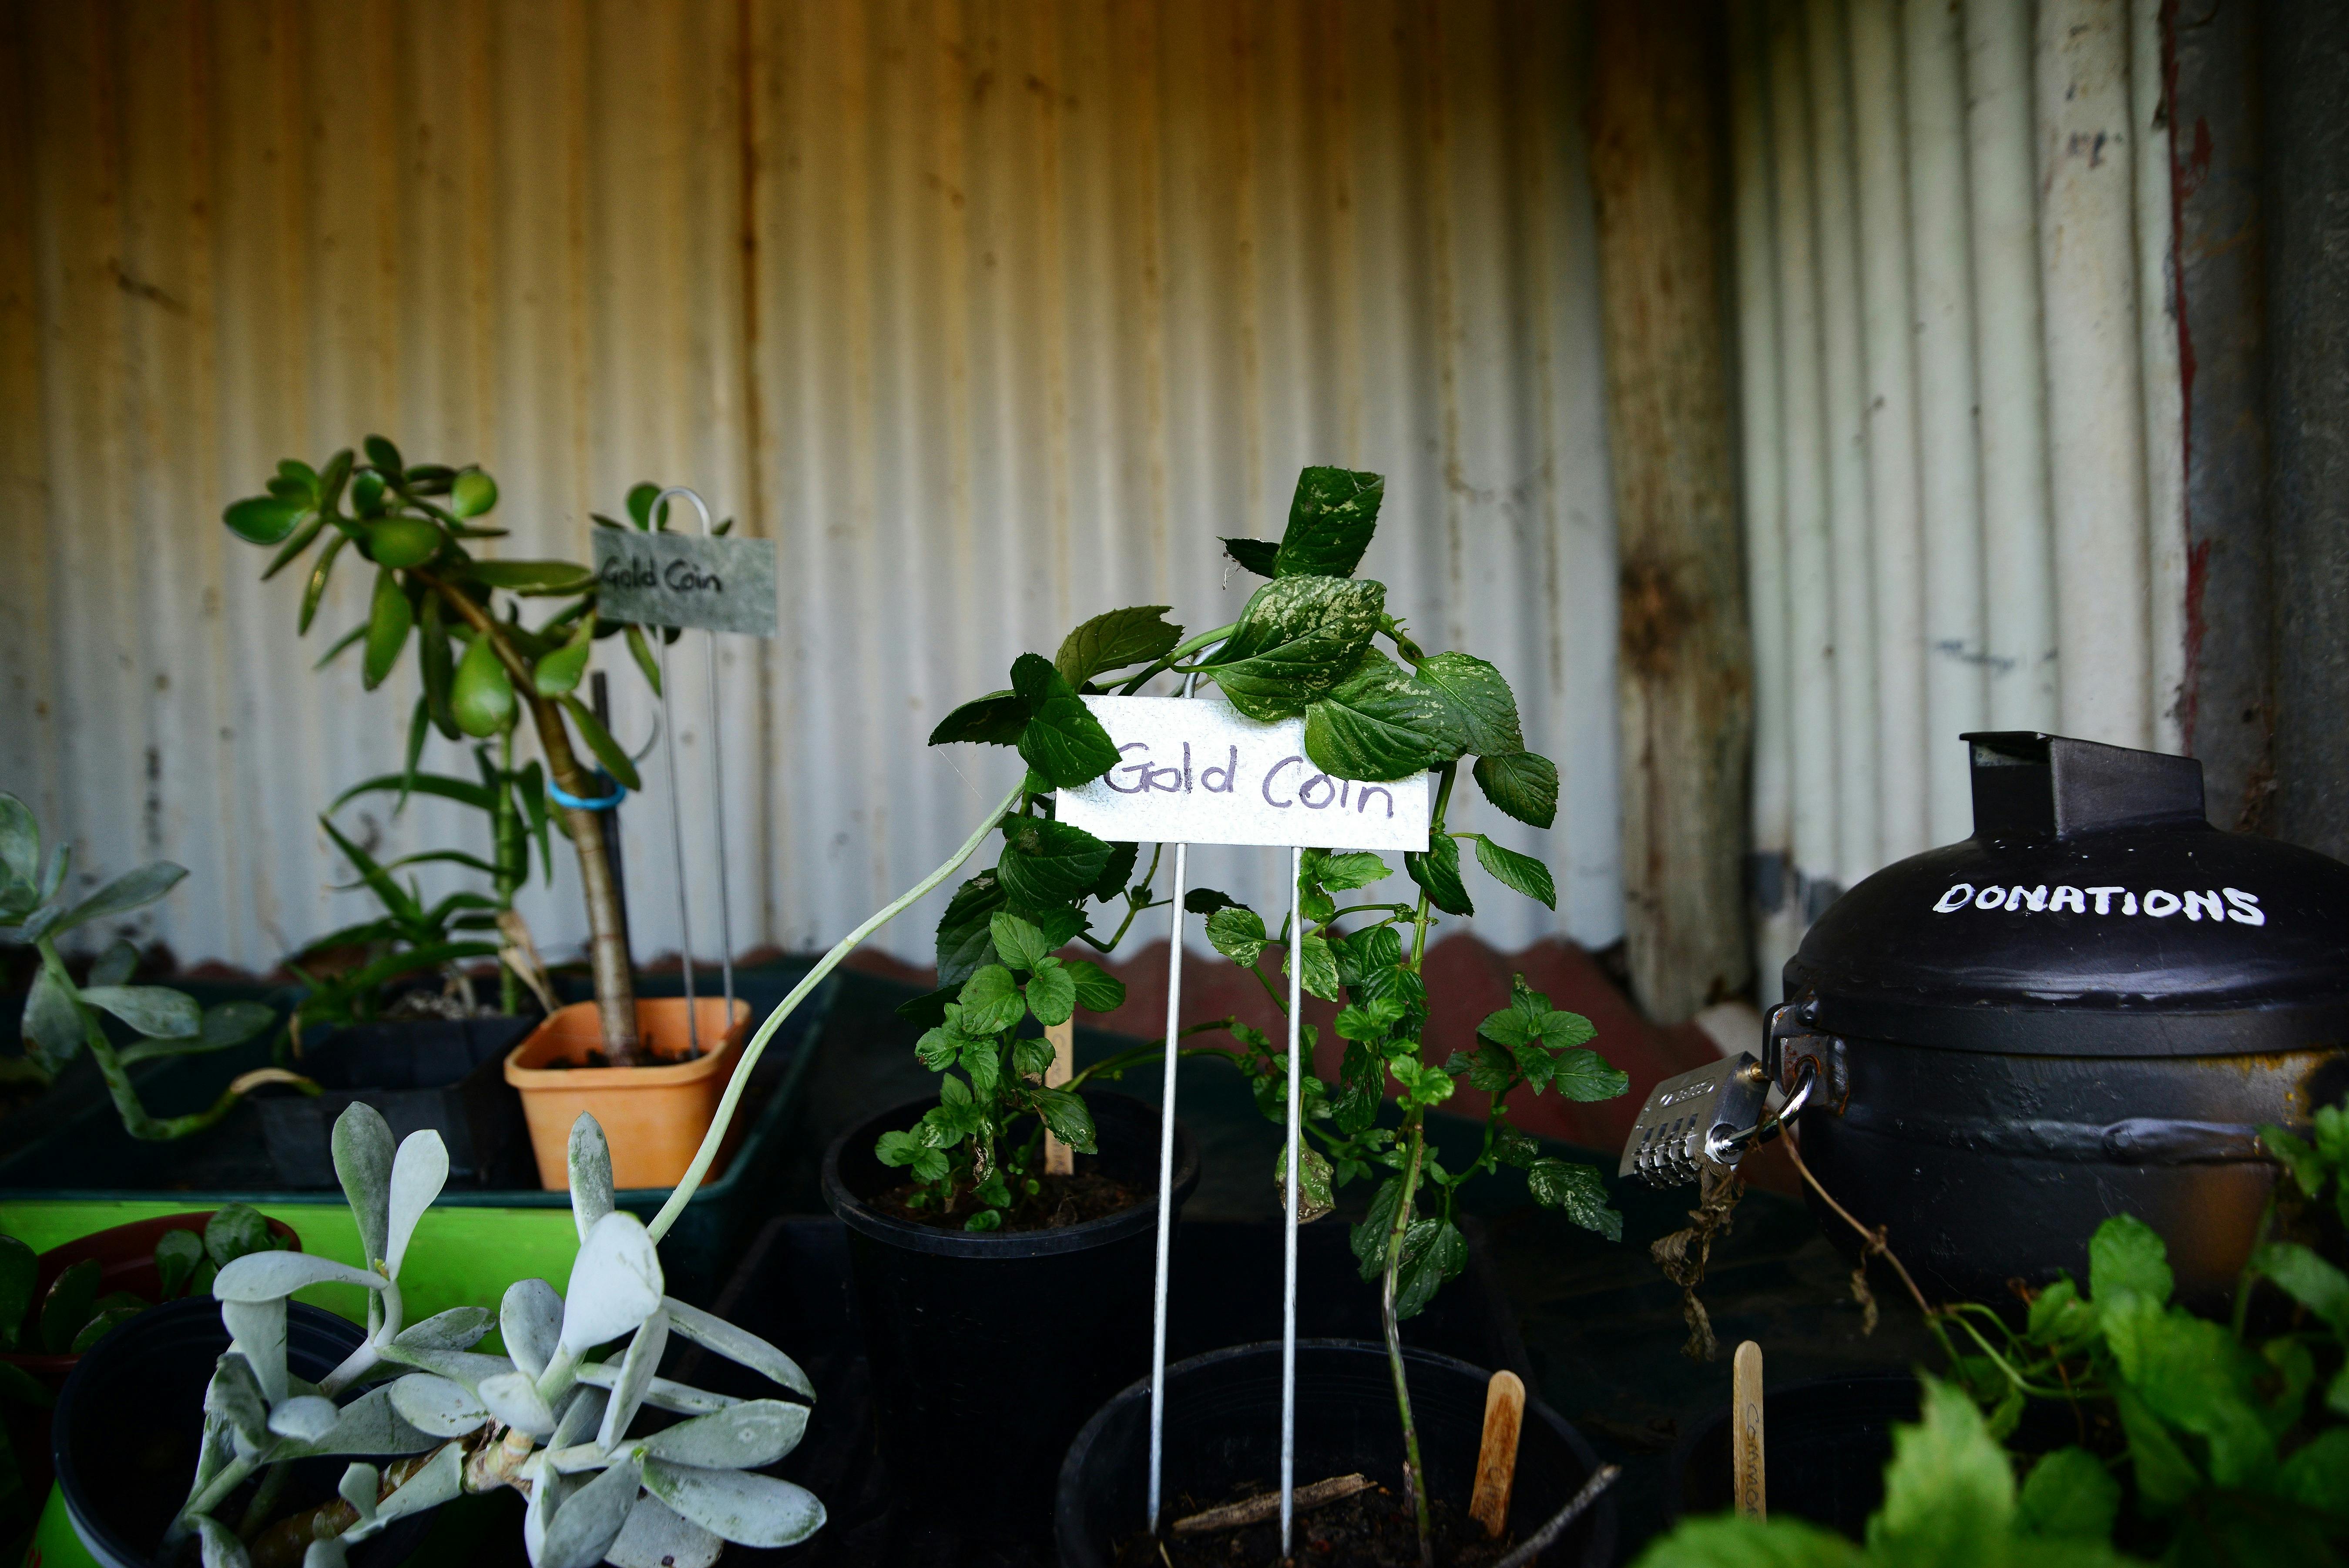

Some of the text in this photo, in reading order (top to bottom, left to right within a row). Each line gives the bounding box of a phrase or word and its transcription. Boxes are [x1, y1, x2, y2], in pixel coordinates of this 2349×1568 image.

[601, 553, 722, 594] Gold Coin
[1104, 741, 1393, 819] Gold Coin
[1932, 883, 2265, 926] DONATIONS
